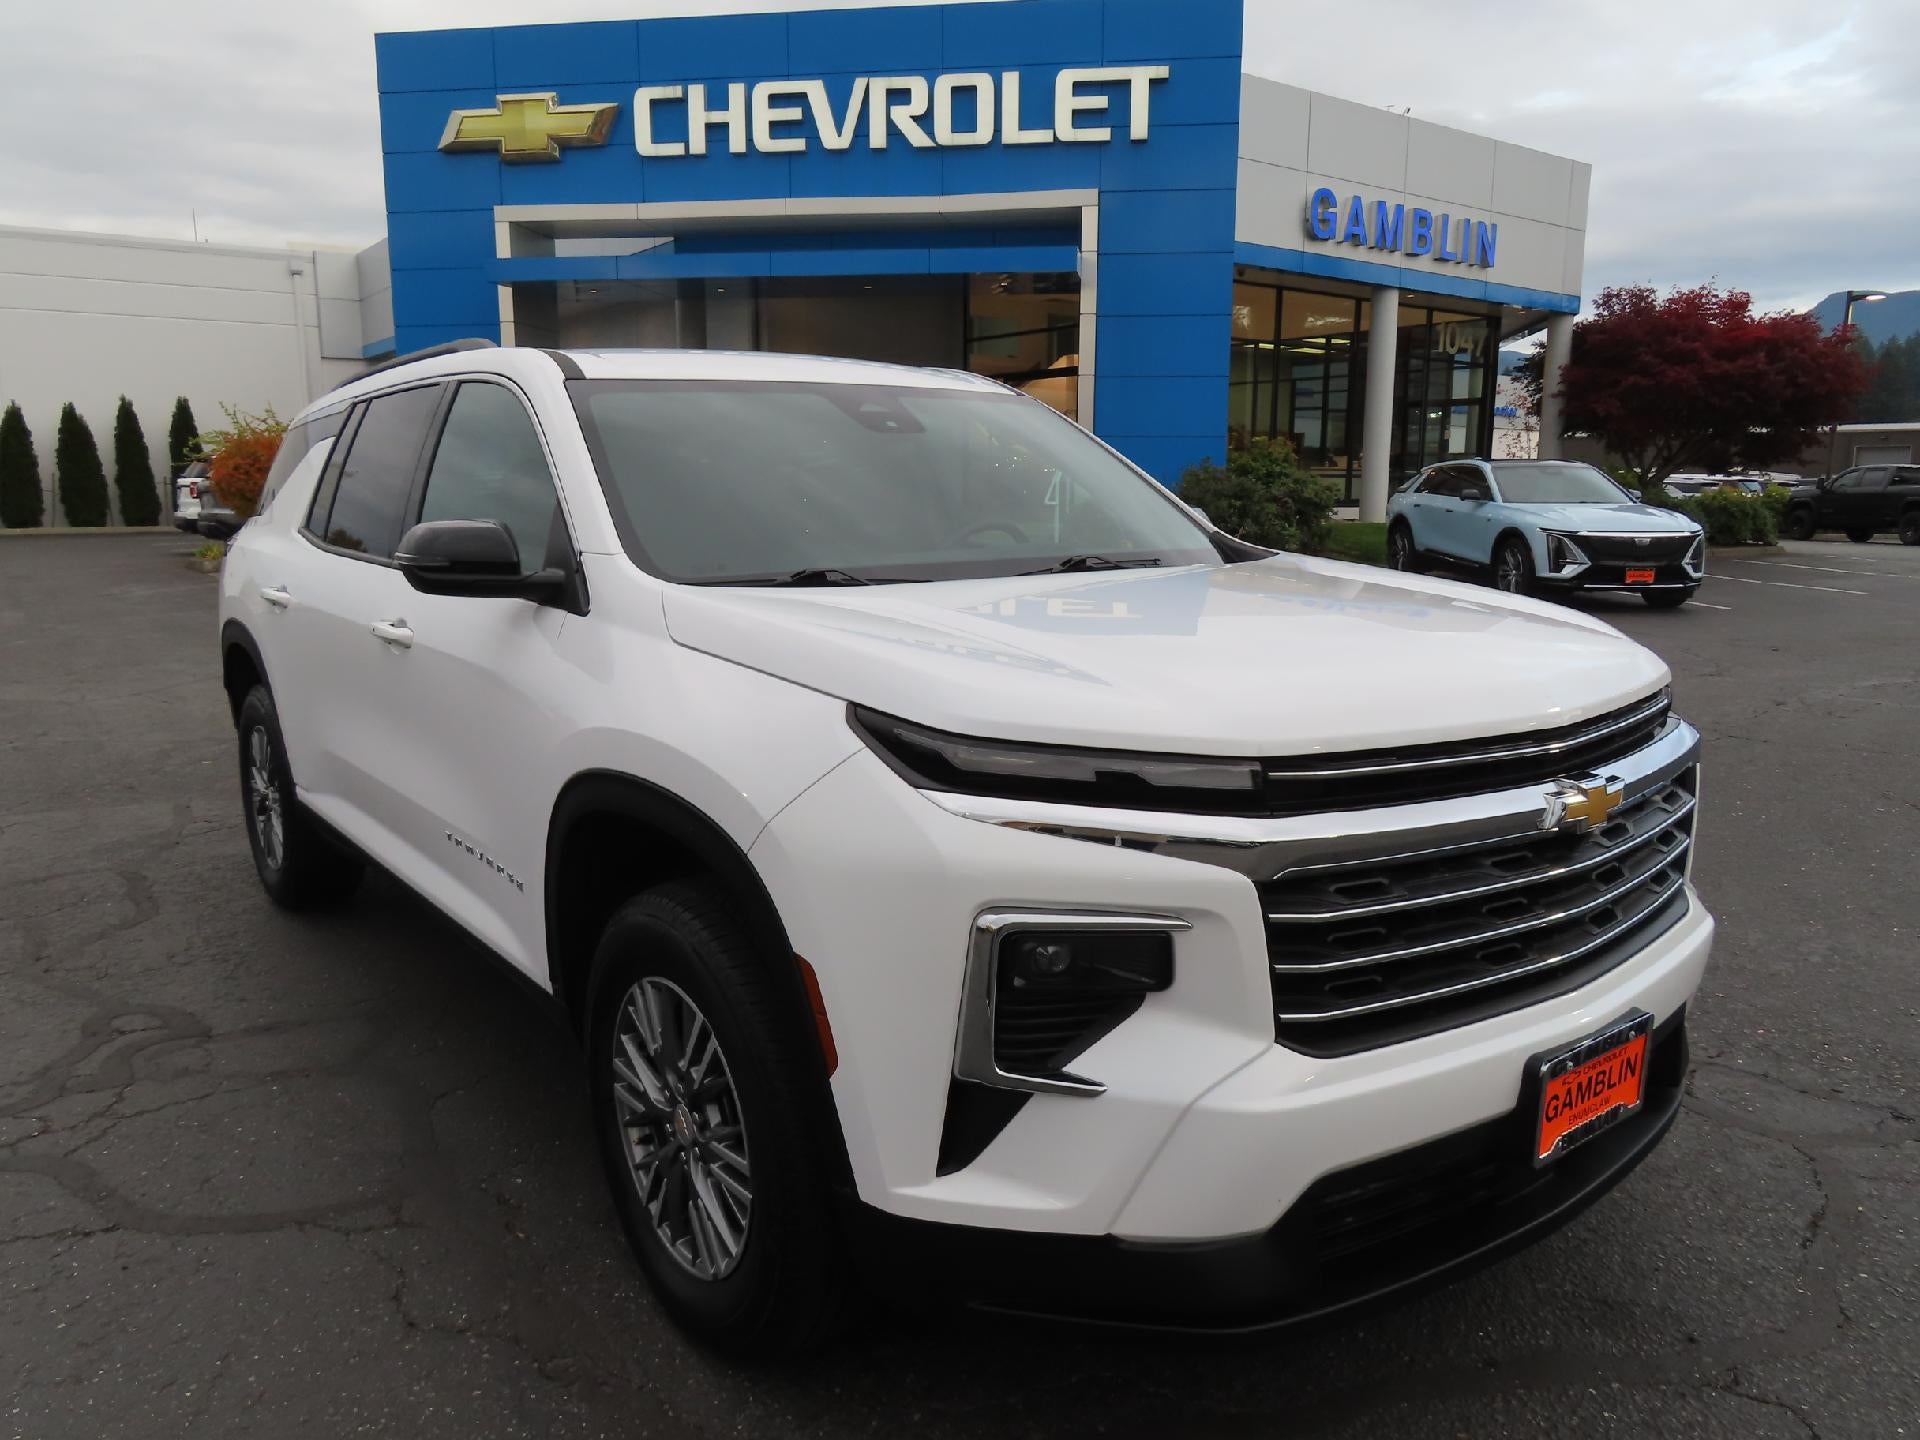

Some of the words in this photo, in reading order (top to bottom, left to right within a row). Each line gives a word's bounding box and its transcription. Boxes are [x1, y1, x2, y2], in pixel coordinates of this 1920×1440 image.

[633, 65, 1169, 157] CHEVROLET
[1309, 187, 1497, 268] GAMBLIN
[1436, 323, 1488, 358] 1047
[1545, 1053, 1638, 1123] GAMBLIN
[1568, 1096, 1611, 1125] ENUMCLAW
